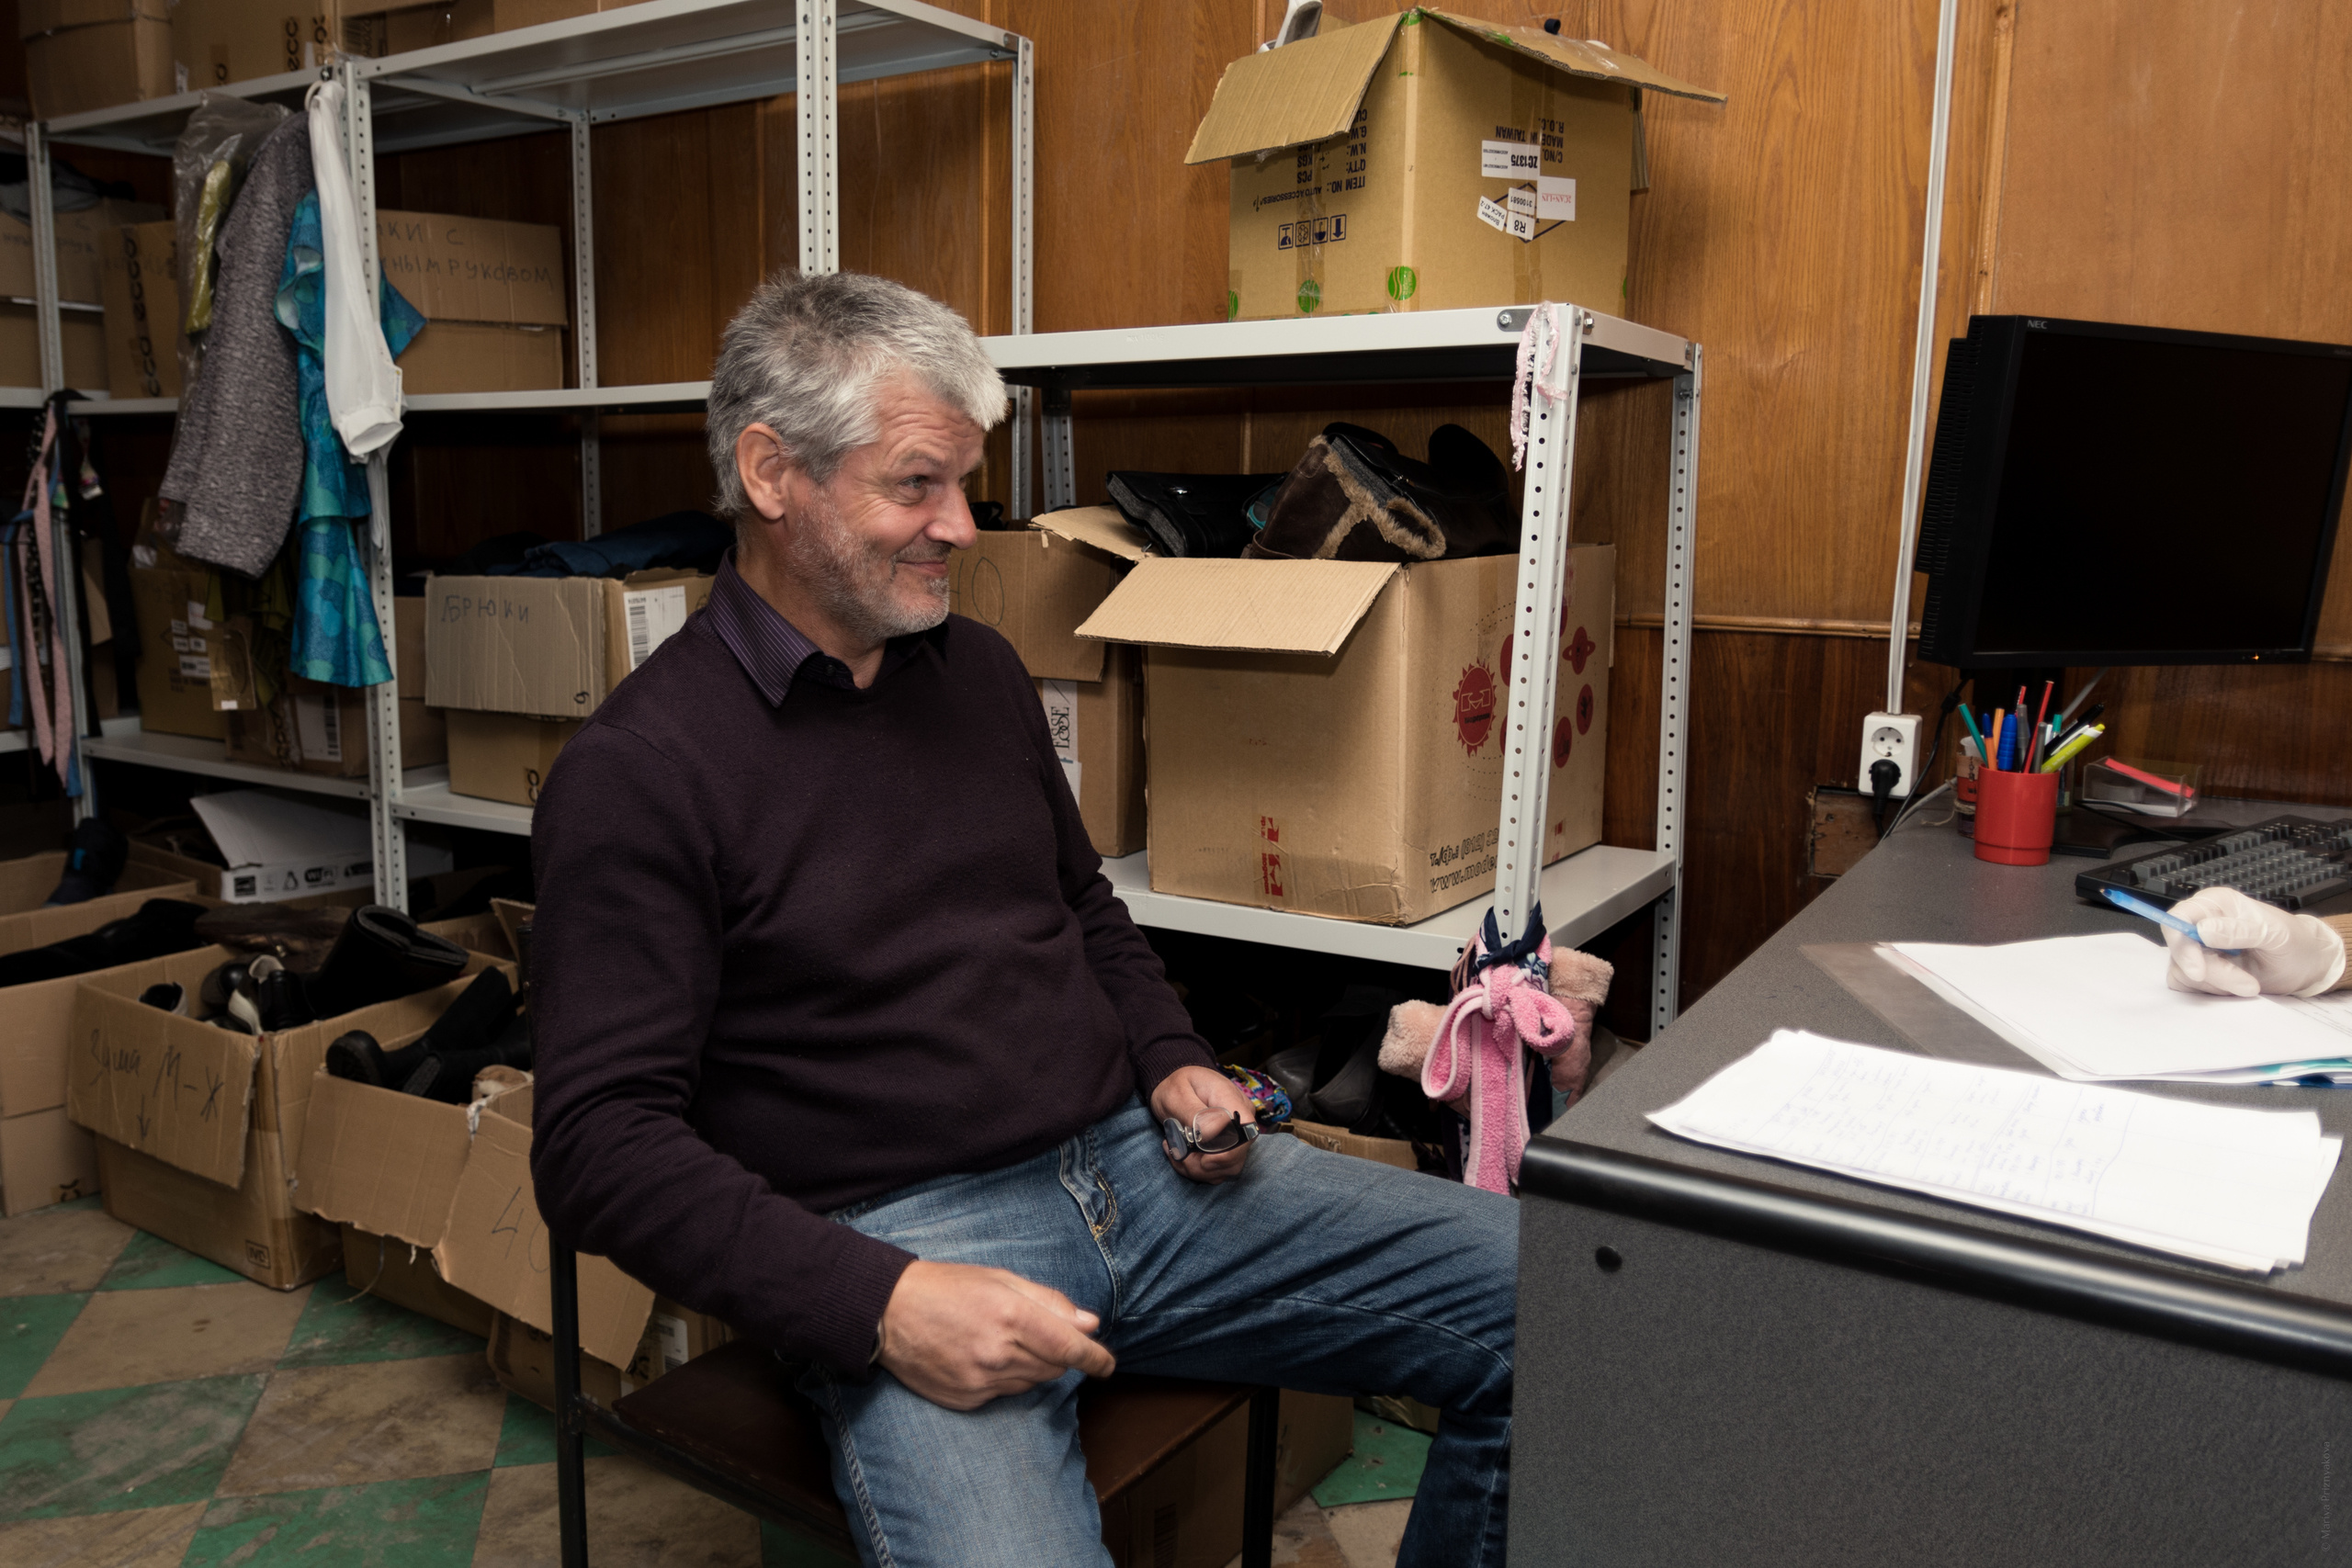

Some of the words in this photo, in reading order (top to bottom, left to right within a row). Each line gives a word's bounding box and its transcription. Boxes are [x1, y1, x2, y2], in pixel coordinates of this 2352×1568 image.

[1495, 125, 1526, 142] TAIWAN
[1530, 131, 1538, 144] IN
[1541, 133, 1564, 149] MADE
[1296, 153, 1313, 167] KGS
[1510, 154, 1538, 169] ZC1375
[1542, 149, 1563, 164] C/NO.
[1296, 170, 1313, 185] PCS
[1345, 175, 1366, 191] ITEM
[1262, 189, 1305, 205] ACCESSORIES
[1305, 186, 1322, 197] AUTO
[1510, 196, 1532, 208] 3100581
[1490, 207, 1505, 220] PACK
[1513, 220, 1527, 233] R8
[2027, 319, 2049, 330] NEC
[441, 594, 529, 624] БРЮКИ
[1050, 705, 1070, 750] ESSE
